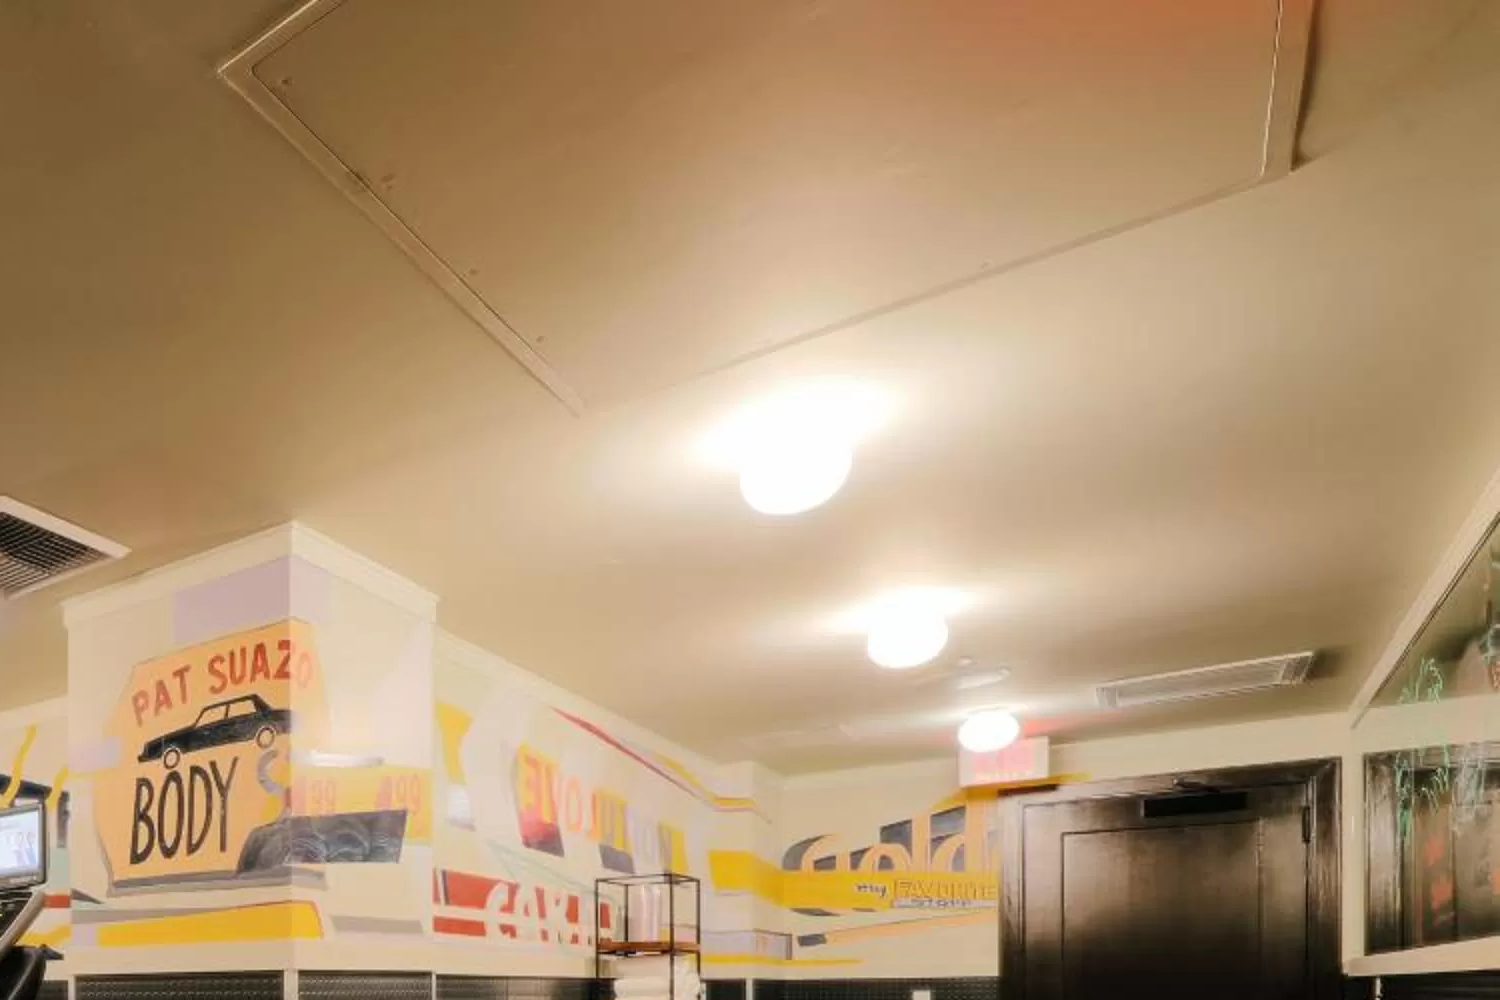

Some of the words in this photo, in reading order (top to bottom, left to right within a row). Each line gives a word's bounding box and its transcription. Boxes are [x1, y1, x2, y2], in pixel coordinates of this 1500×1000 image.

[131, 665, 192, 726] PAT
[207, 639, 313, 696] SUAZO
[129, 756, 239, 866] BODY
